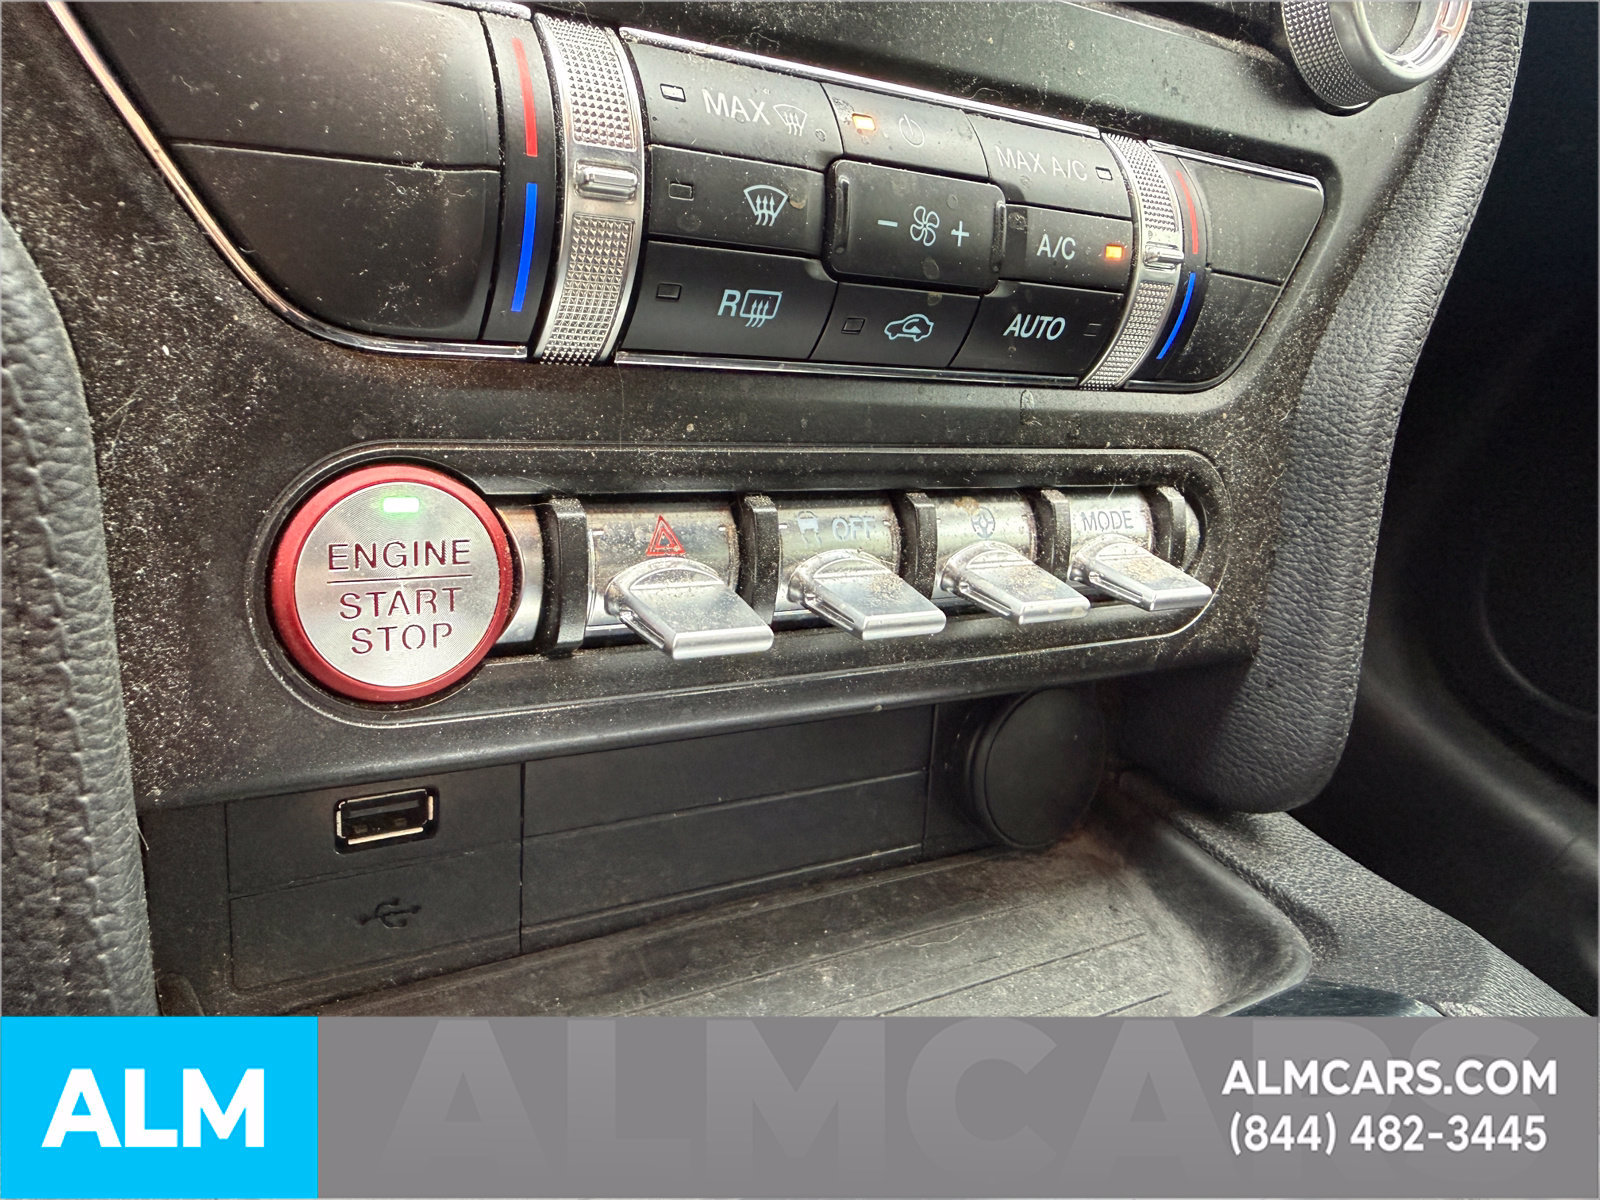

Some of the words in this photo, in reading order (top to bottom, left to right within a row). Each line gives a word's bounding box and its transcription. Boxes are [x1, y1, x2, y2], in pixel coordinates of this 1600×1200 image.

[702, 88, 771, 126] MAX
[996, 145, 1046, 177] MAX
[1050, 156, 1089, 182] A/C
[1036, 233, 1077, 261] A/C
[716, 289, 739, 317] R
[1003, 313, 1067, 342] AUTO
[832, 515, 876, 542] OFF
[1080, 509, 1135, 534] MODE
[327, 538, 472, 572] ENGINE
[339, 587, 463, 621] START
[350, 622, 453, 655] STOP
